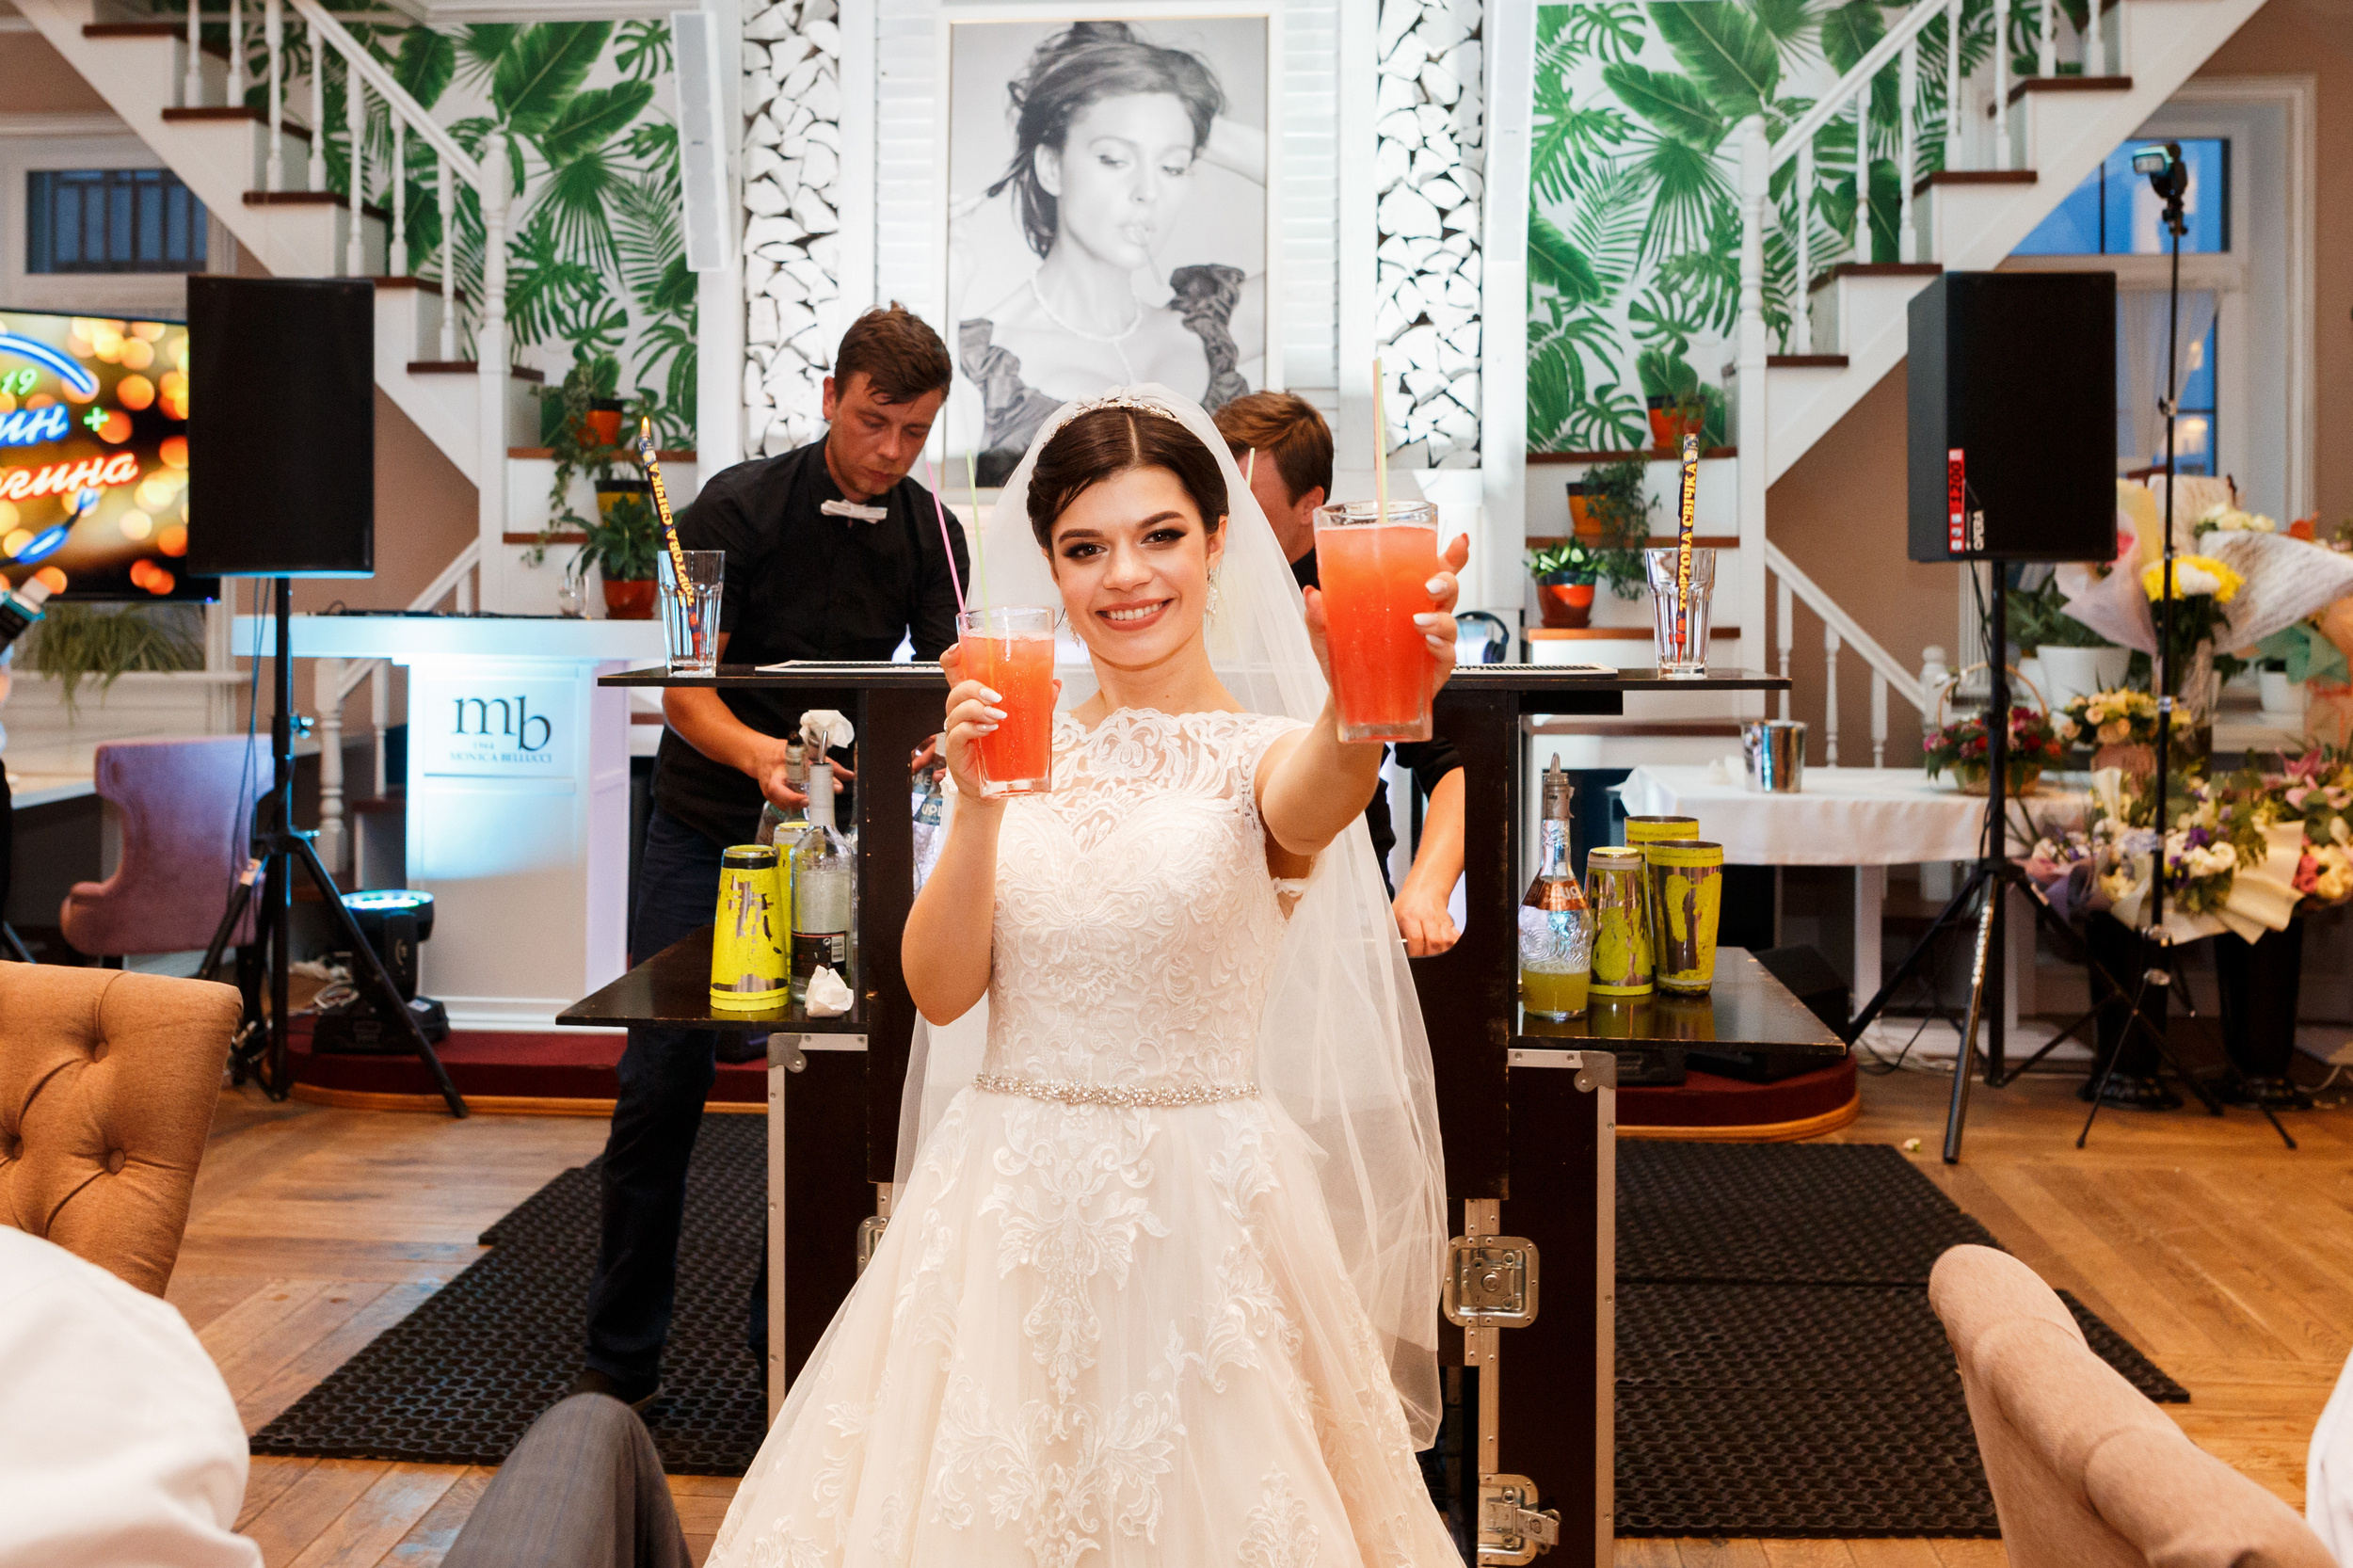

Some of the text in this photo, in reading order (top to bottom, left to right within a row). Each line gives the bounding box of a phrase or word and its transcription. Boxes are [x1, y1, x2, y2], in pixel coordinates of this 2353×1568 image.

[648, 461, 674, 525] СВІЧКА
[1682, 462, 1697, 527] СВІЧКА
[1949, 461, 1962, 502] 1200
[451, 695, 552, 751] mb
[449, 751, 552, 764] MONICA BELLUCCI
